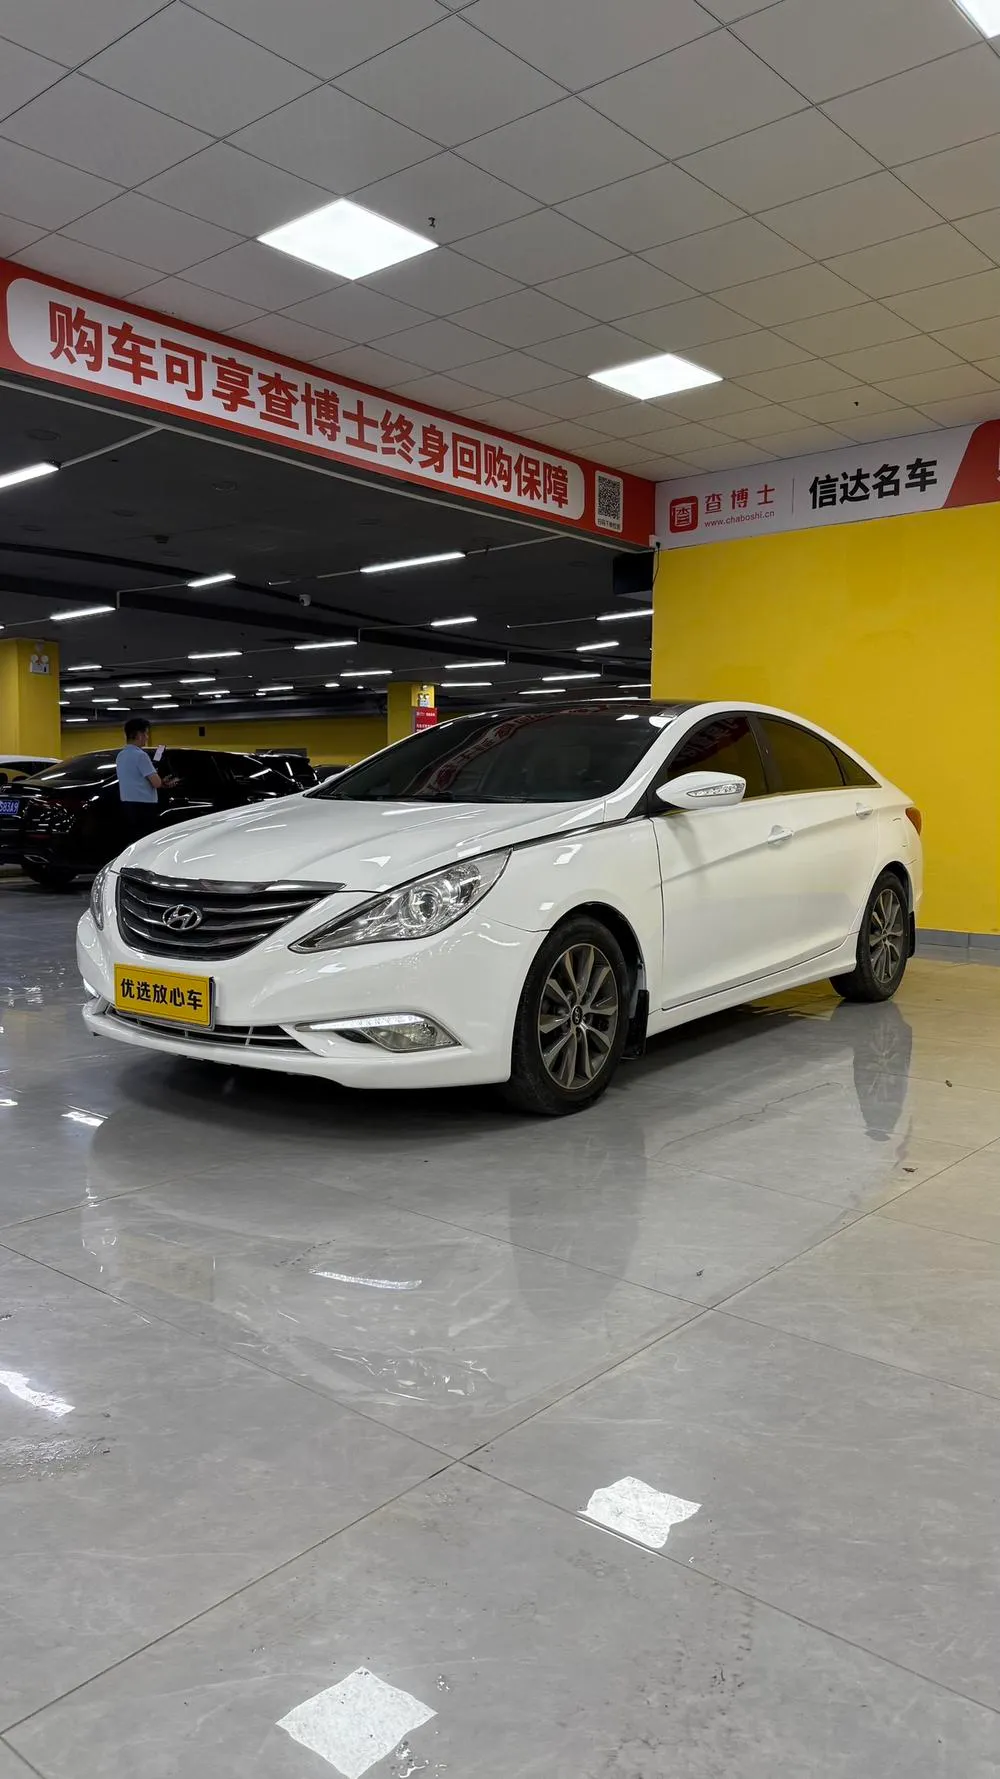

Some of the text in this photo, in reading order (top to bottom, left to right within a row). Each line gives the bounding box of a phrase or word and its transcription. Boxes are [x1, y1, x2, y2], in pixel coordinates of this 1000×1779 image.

[49, 301, 568, 508] 购车可享查博士终身回购保障
[704, 484, 776, 514] 查博士
[809, 458, 937, 509] 信达名车
[704, 510, 775, 528] www.chaboshi.cn
[120, 978, 203, 1011] 优选放心车
